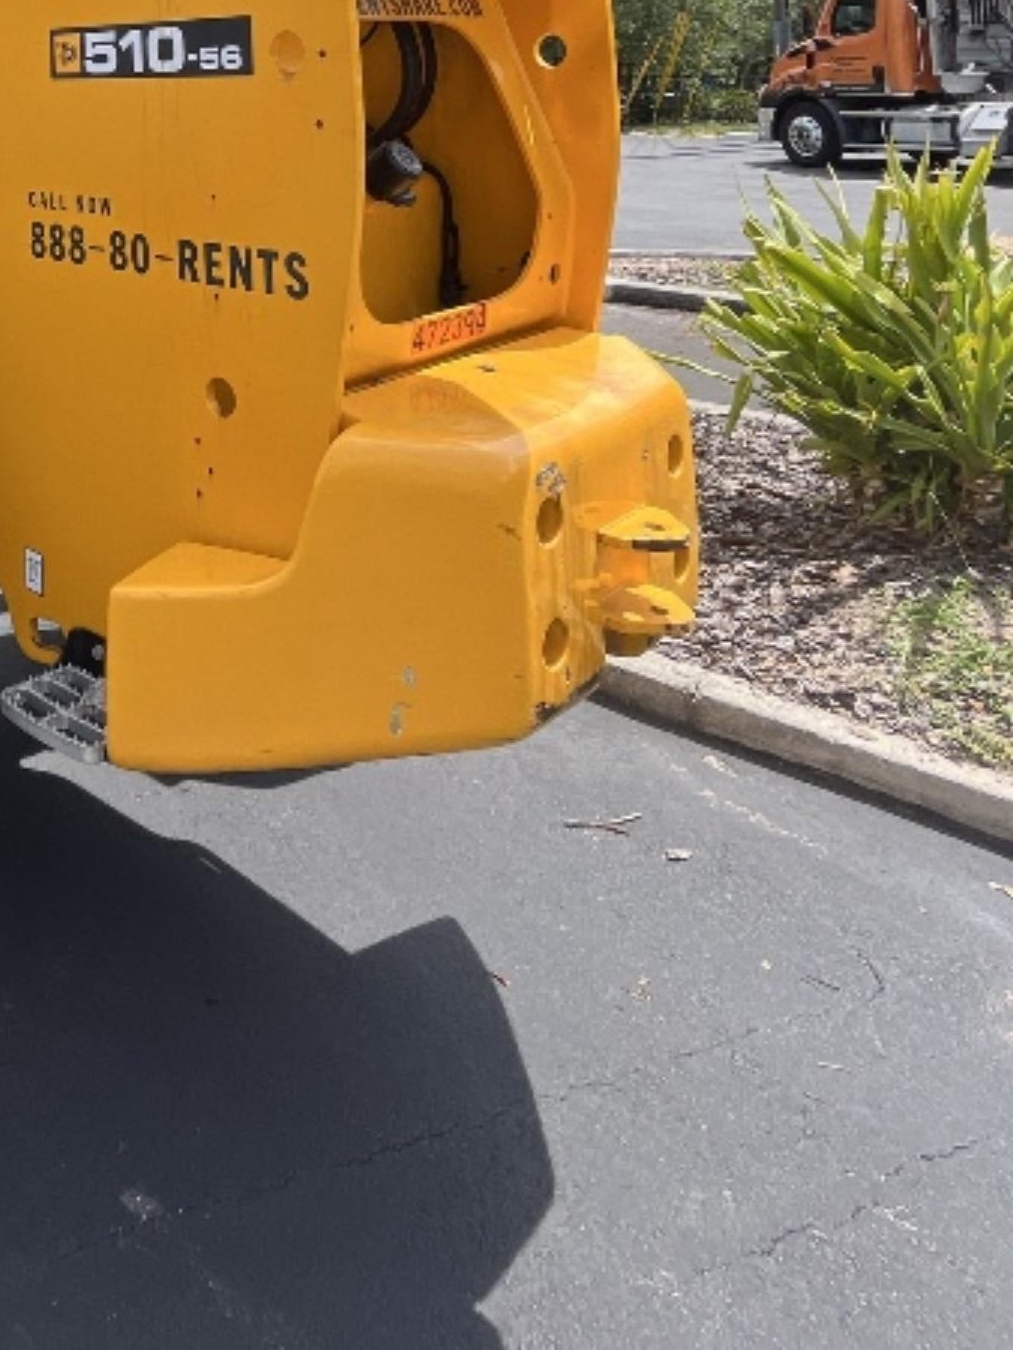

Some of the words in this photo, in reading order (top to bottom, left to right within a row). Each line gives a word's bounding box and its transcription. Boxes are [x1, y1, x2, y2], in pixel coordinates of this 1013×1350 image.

[28, 191, 67, 211] CALL
[76, 195, 112, 217] NOW
[31, 221, 309, 300] 888-80-RENTS
